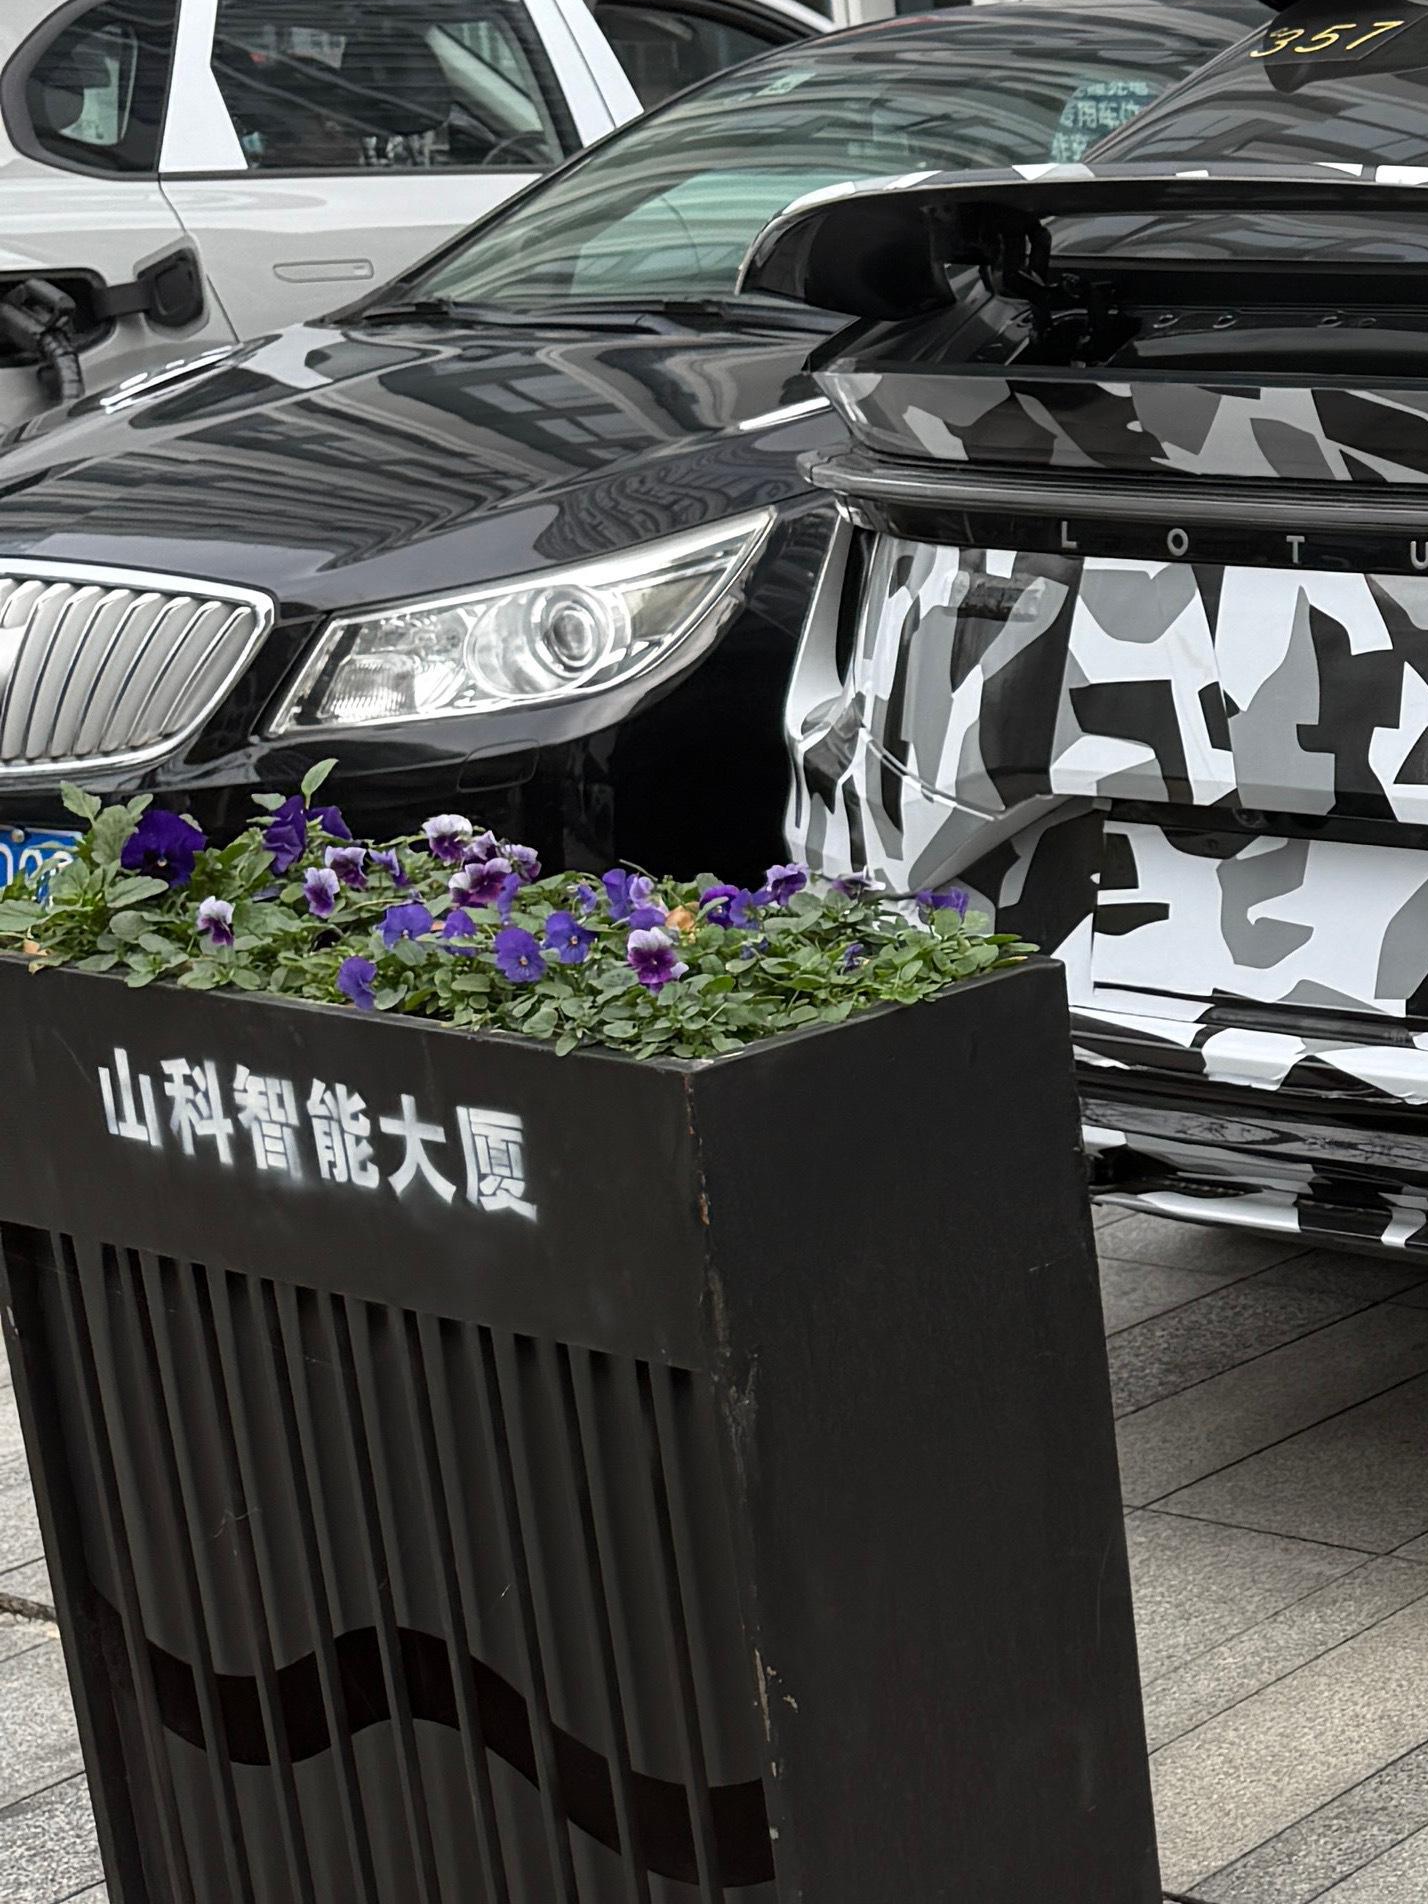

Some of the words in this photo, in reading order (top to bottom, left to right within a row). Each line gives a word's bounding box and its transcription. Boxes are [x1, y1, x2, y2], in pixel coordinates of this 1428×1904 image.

[1250, 20, 1405, 58] 357
[98, 1047, 538, 1222] 山科智能大厦
